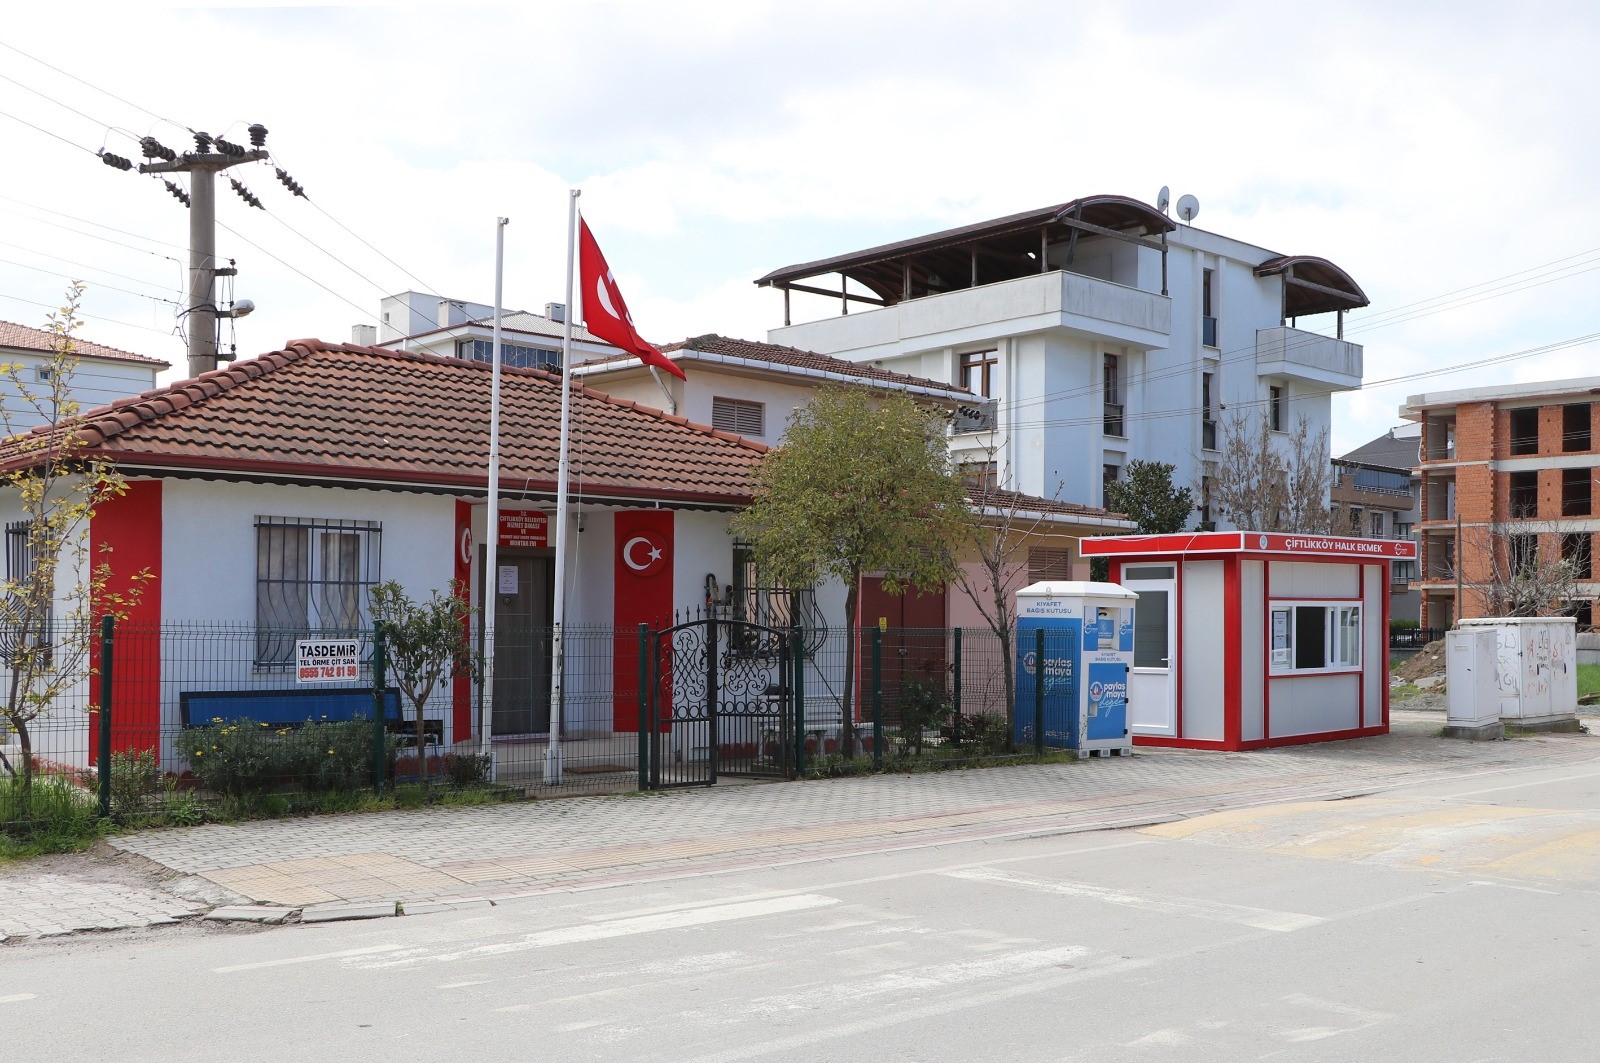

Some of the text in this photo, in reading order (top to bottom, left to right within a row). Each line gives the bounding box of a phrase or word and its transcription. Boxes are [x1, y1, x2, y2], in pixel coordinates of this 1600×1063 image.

[1286, 538, 1382, 552] ÇİFTLİKKÖY HALK EKMEK
[332, 658, 341, 666] ÇİT
[320, 666, 334, 677] 742
[1106, 691, 1126, 699] maya
